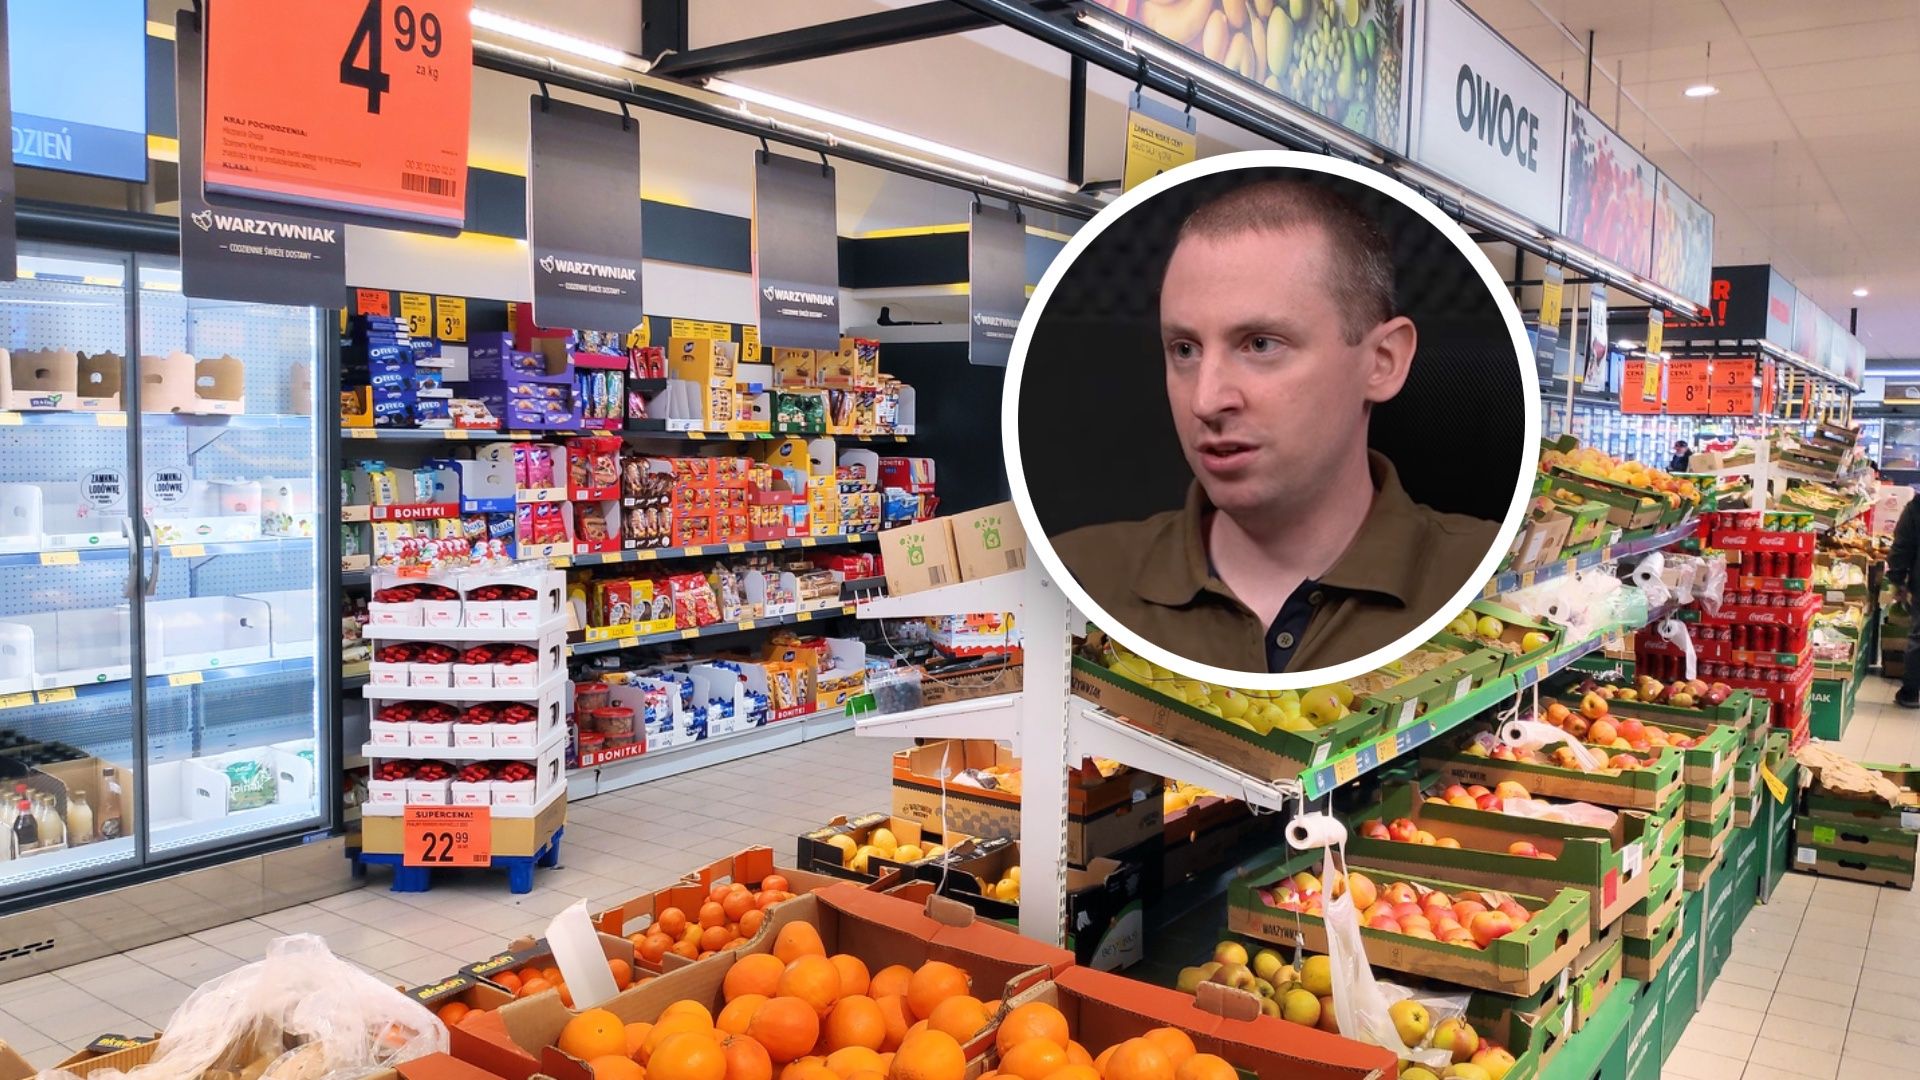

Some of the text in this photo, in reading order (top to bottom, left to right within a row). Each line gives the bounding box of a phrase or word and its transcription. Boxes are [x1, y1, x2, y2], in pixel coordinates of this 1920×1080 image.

[340, 0, 443, 115] 4 99
[428, 64, 440, 82] kg
[1455, 63, 1539, 173] OWOCE
[12, 126, 72, 163] DZIEŃ
[214, 214, 336, 245] WARZYWNIAK
[554, 258, 637, 282] WARZYWNIAK
[774, 288, 835, 307] WARZYWNIAK
[409, 315, 418, 333] 5
[444, 317, 453, 335] 3
[371, 347, 399, 357] OREO
[373, 374, 402, 384] OREO
[1727, 372, 1736, 385] 3
[1685, 385, 1694, 401] 8
[376, 402, 405, 412] OREO
[1727, 399, 1735, 413] 3
[91, 473, 119, 484] ZAMKNIJ
[156, 472, 182, 482] ZAMKNIJ
[394, 506, 445, 518] BONITKI
[1812, 693, 1831, 703] IAK
[778, 705, 806, 719] BONITKI
[598, 744, 642, 762] BONITKI
[415, 810, 474, 819] SUPERCENA!
[421, 831, 469, 862] 22 99
